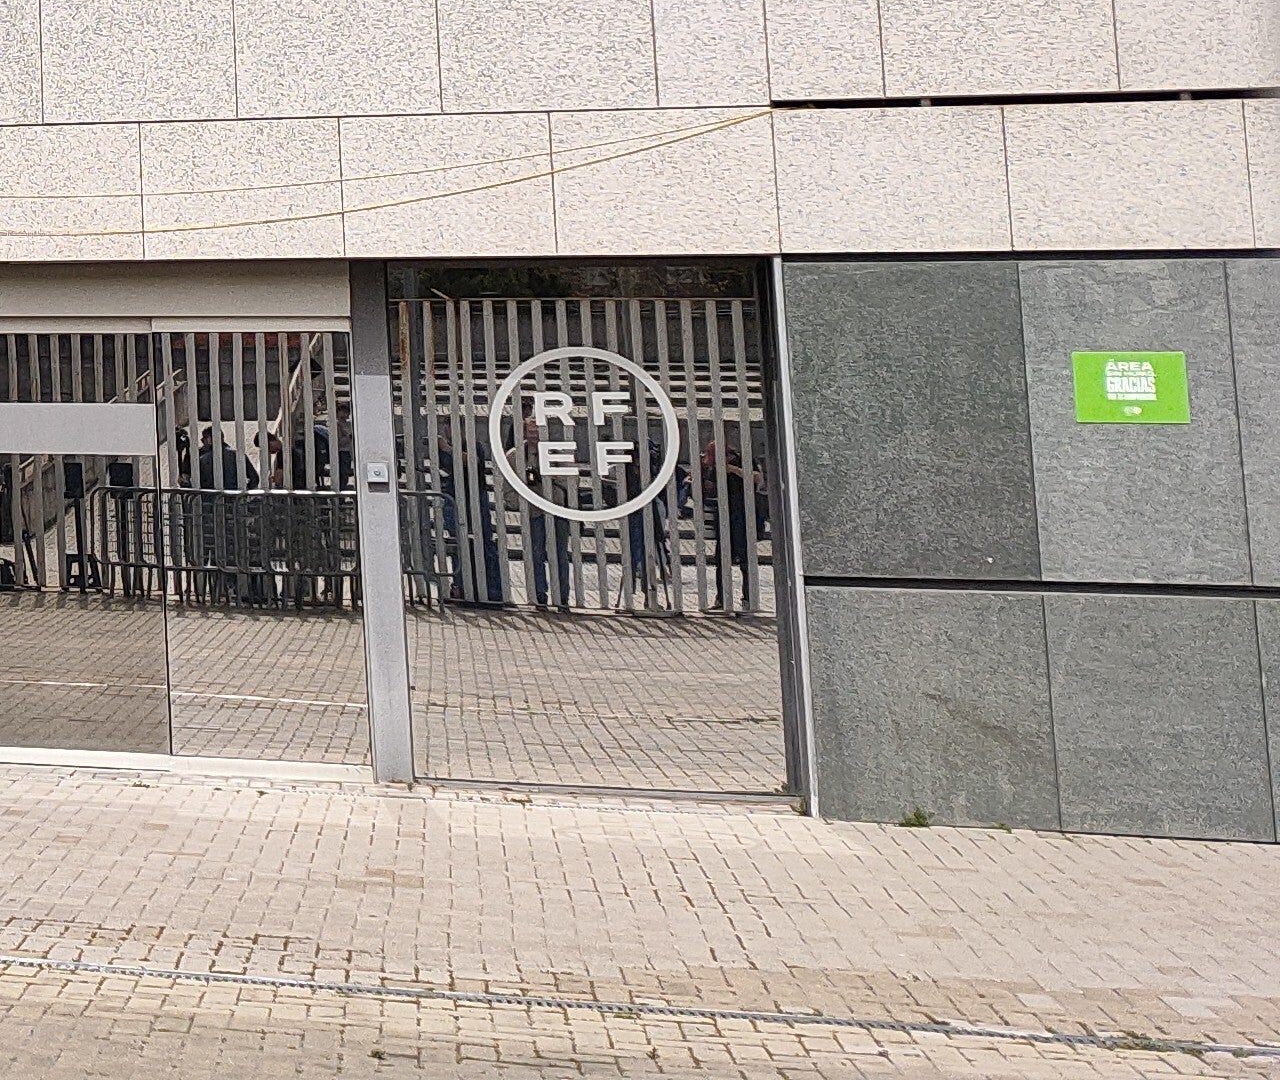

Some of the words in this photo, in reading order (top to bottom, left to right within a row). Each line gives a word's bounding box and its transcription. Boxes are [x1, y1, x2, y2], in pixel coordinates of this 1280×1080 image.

[1106, 359, 1154, 371] ÁREA
[1106, 376, 1157, 393] GRACIAS
[533, 391, 632, 426] RF
[537, 441, 634, 476] EF
